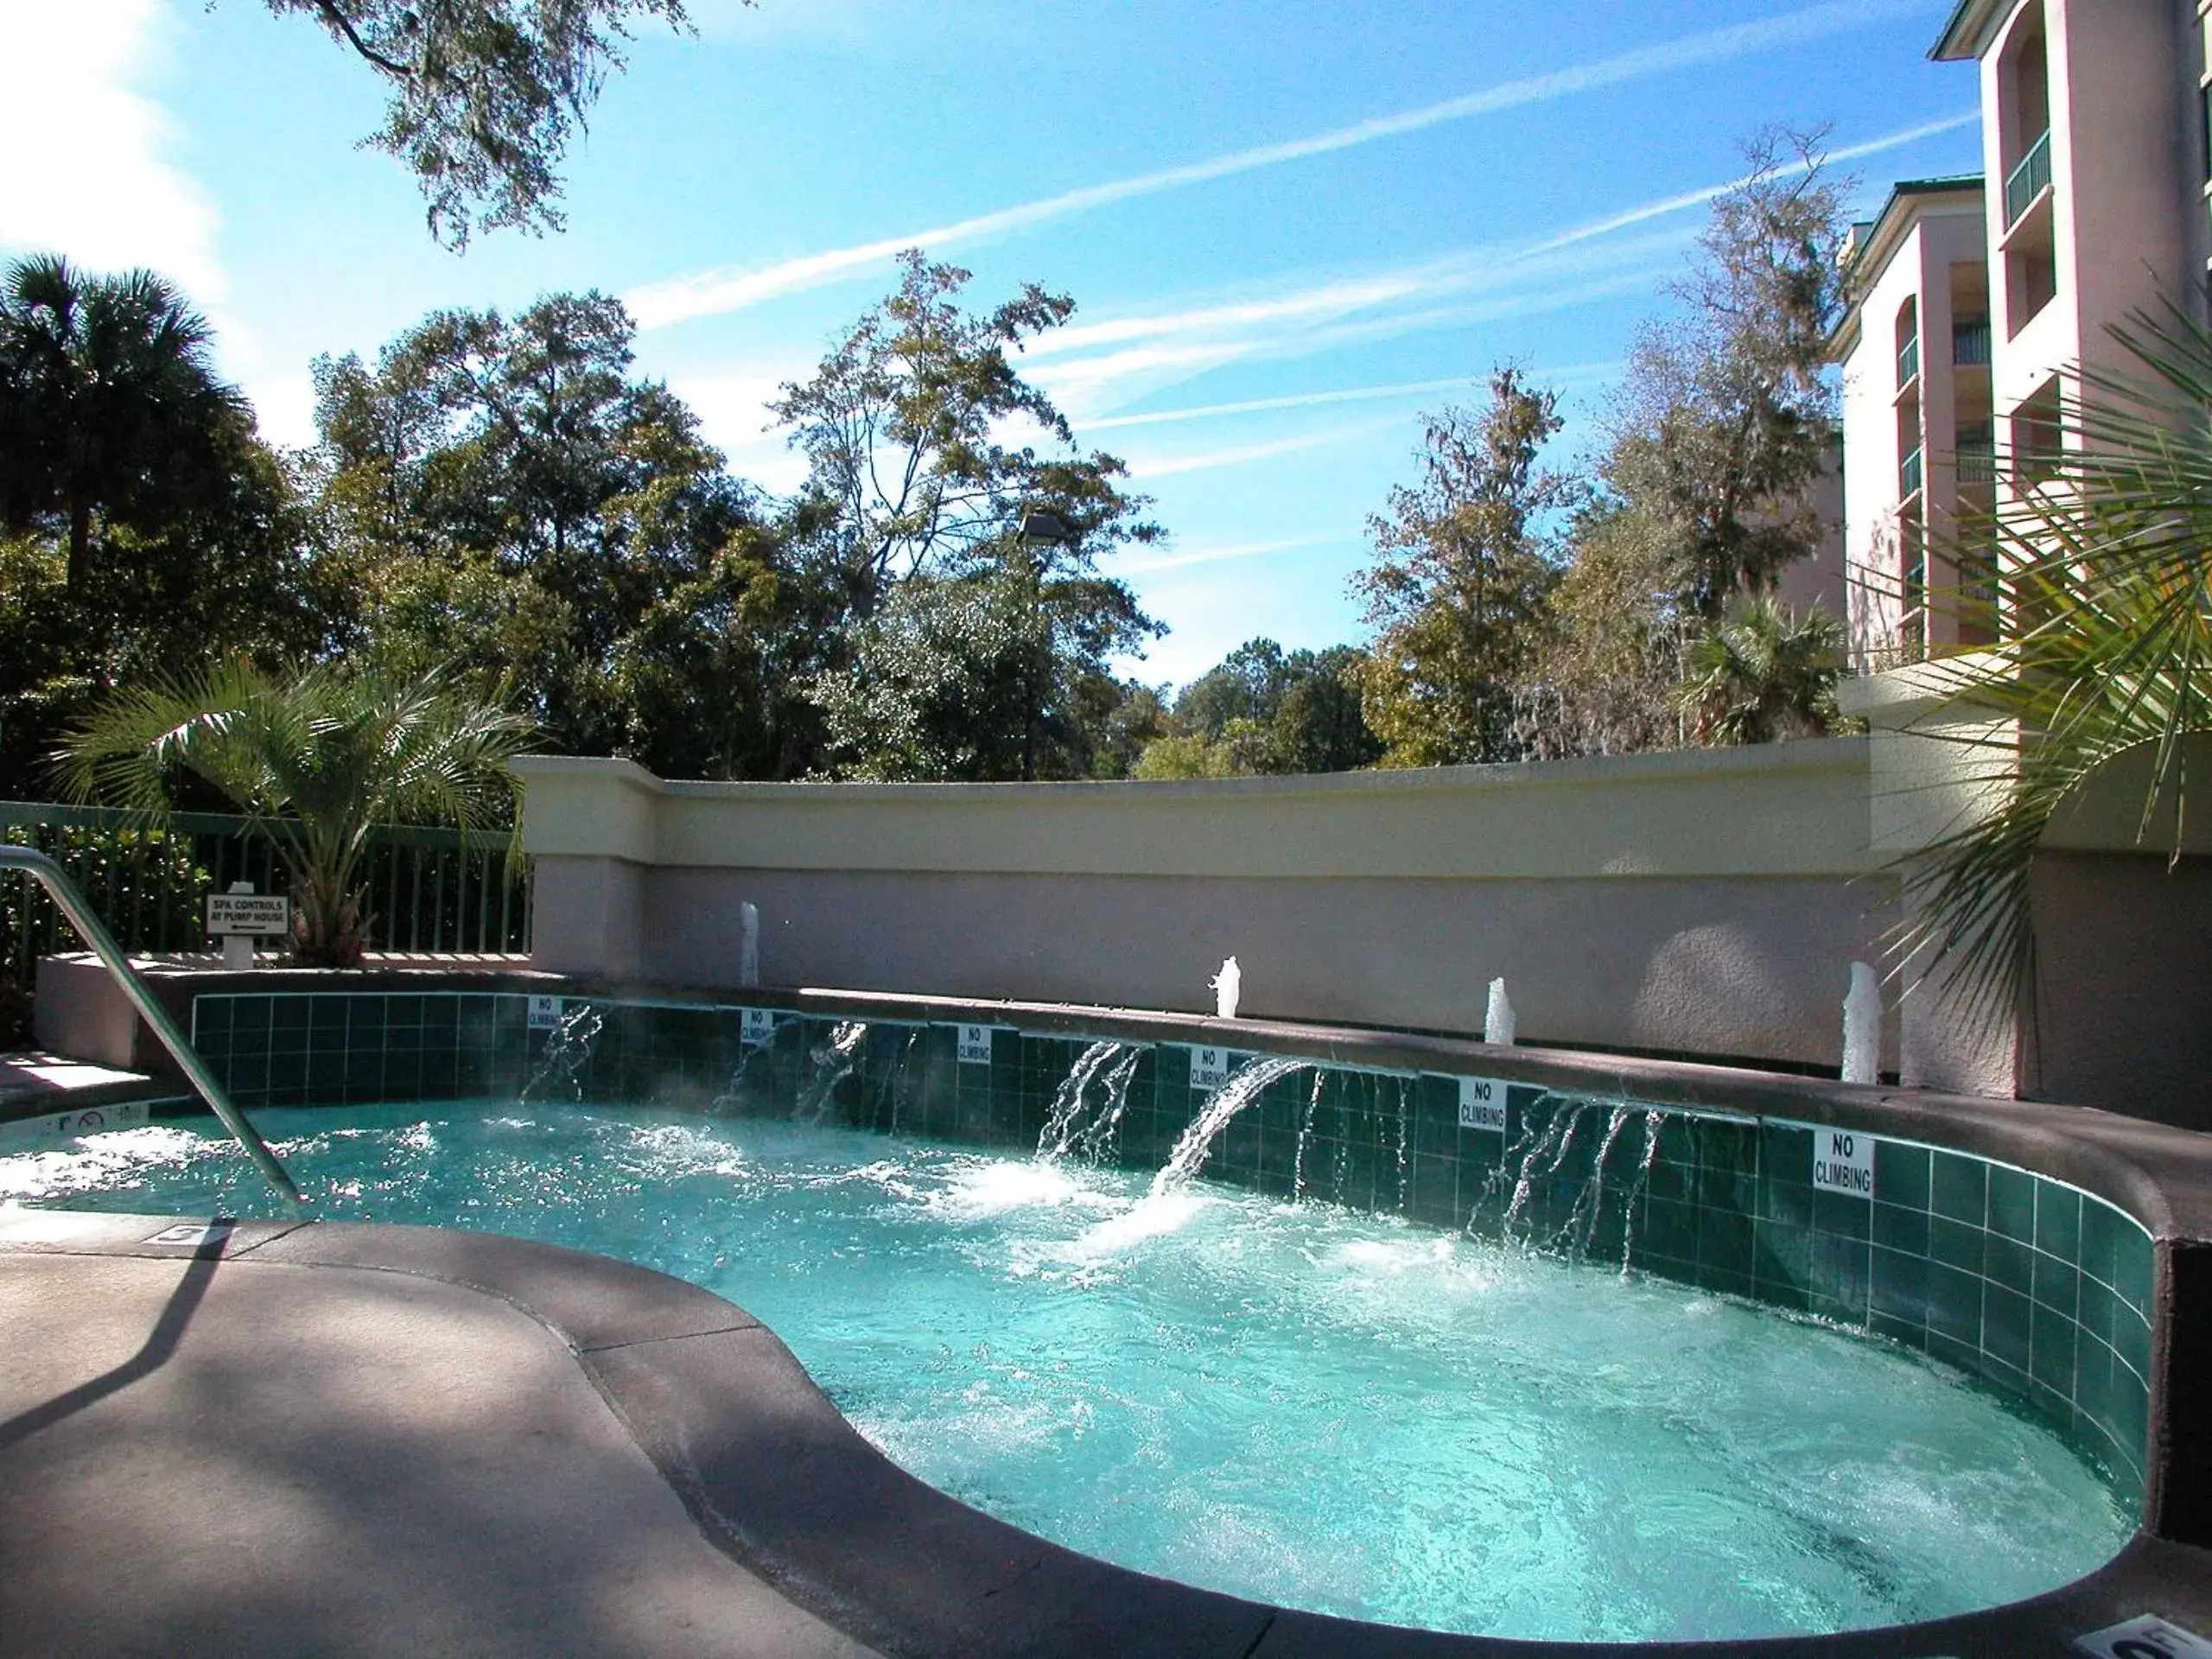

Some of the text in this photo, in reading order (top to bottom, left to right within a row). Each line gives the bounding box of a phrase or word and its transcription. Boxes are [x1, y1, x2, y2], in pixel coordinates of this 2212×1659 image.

[213, 900, 283, 911] SPA CONTROLS
[211, 912, 284, 923] AT PUMP HOUSE
[539, 997, 552, 1011] NO
[752, 1010, 763, 1025] NO
[969, 1027, 981, 1041] NO
[959, 1044, 989, 1061] CLIMBING
[1202, 1049, 1216, 1065] NO
[1474, 1081, 1491, 1100] NO
[1461, 1103, 1503, 1127] CLIMBING
[1832, 1133, 1853, 1158] NO
[1815, 1160, 1871, 1192] CLIMBING
